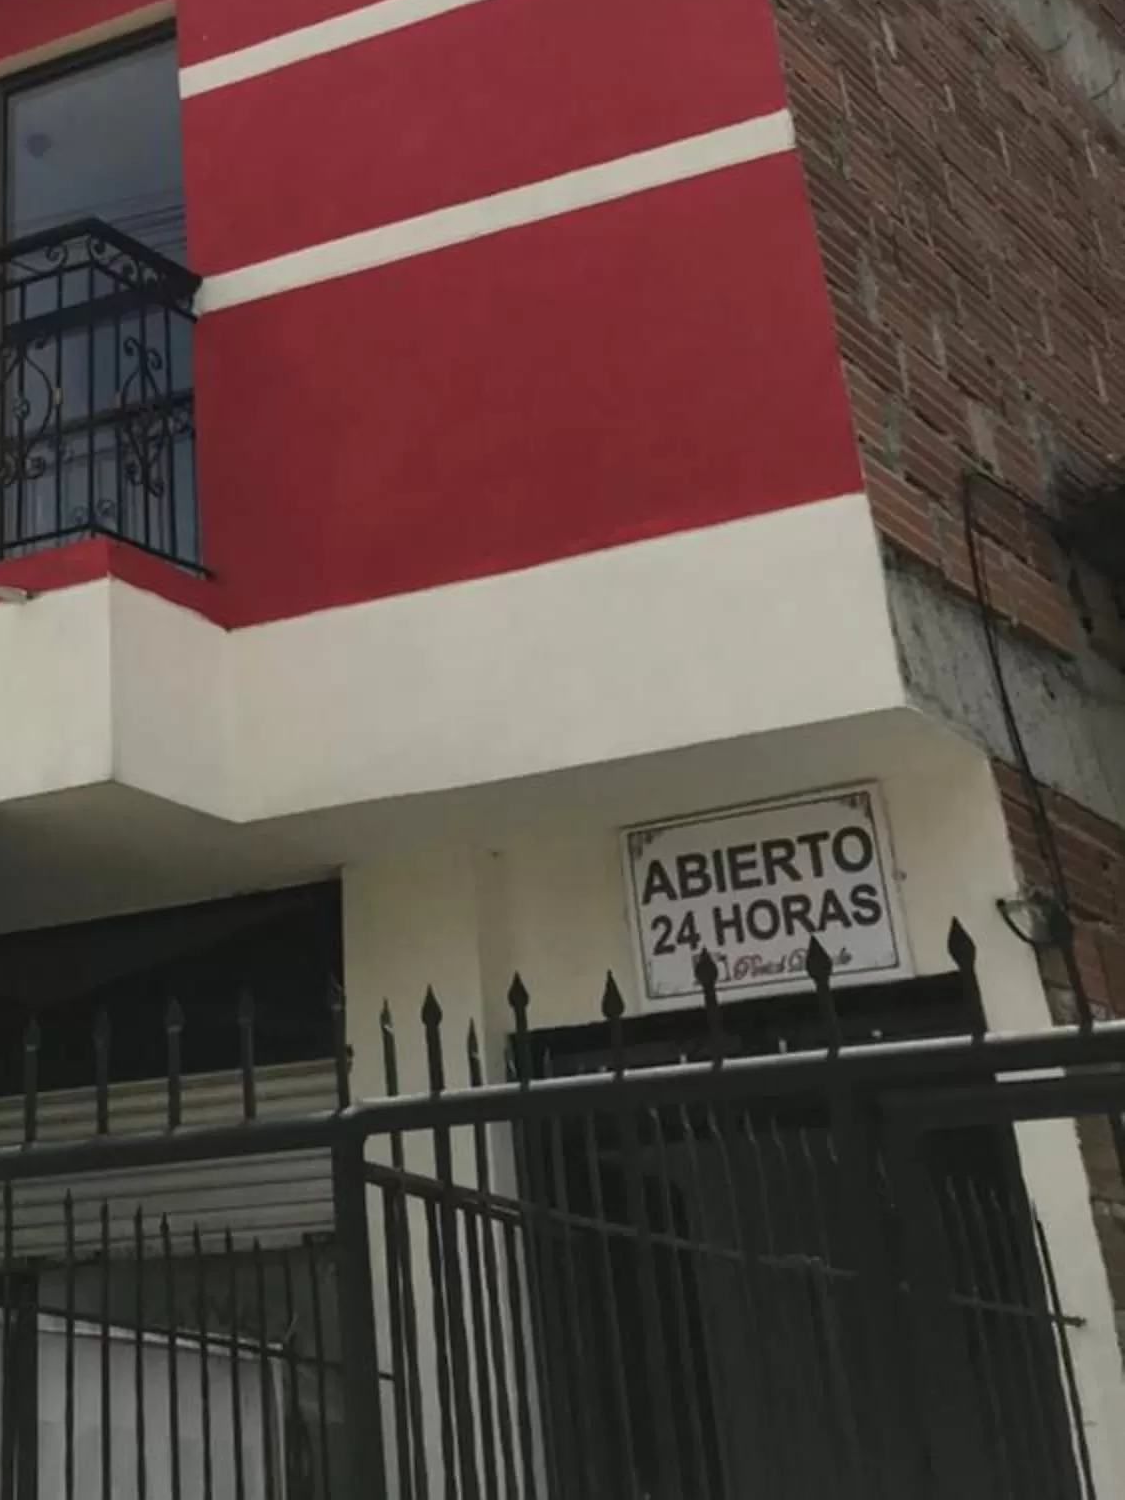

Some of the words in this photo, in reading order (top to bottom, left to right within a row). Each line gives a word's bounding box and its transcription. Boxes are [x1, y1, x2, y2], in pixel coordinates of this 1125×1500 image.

[641, 825, 874, 906] ABIERTO
[650, 910, 701, 956] 24
[712, 883, 883, 946] HORAS
